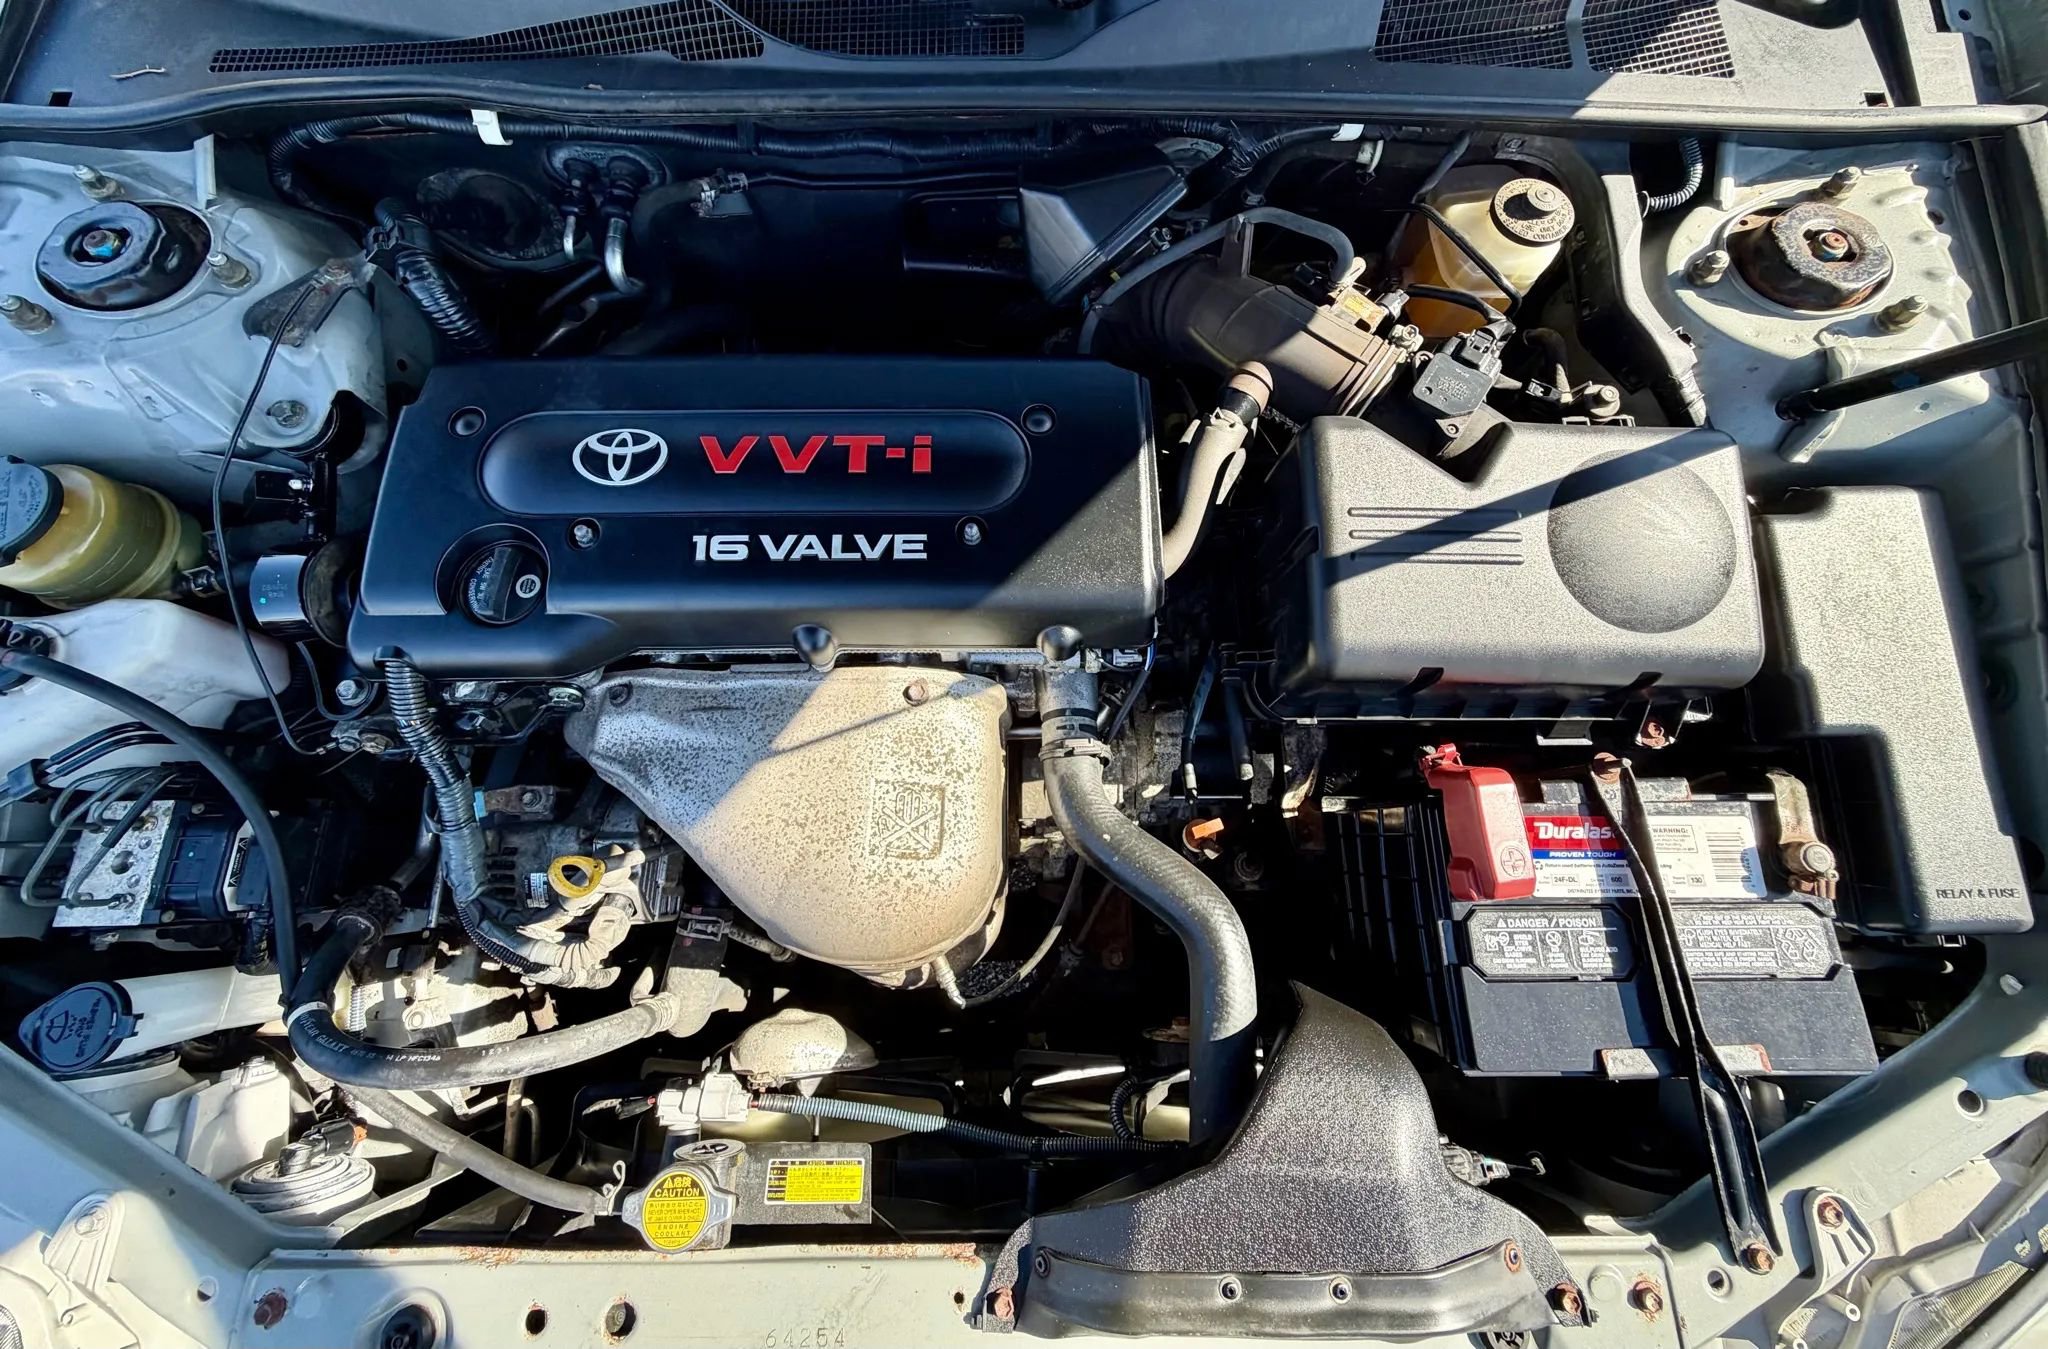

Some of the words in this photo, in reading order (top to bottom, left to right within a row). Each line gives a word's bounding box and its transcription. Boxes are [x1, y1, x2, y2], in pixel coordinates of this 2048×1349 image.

[692, 535, 750, 562] 16
[758, 534, 928, 562] VALVE
[1549, 851, 1585, 859] PROVEN
[1587, 851, 1617, 859] TOUGH
[1935, 888, 1974, 899] RELAY
[1977, 888, 1986, 899] &
[1987, 888, 2021, 899] FUSE
[1507, 918, 1549, 928] DANGER
[1559, 918, 1597, 928] POISON
[654, 1188, 700, 1197] CAUTION
[765, 1327, 845, 1348] 64254
